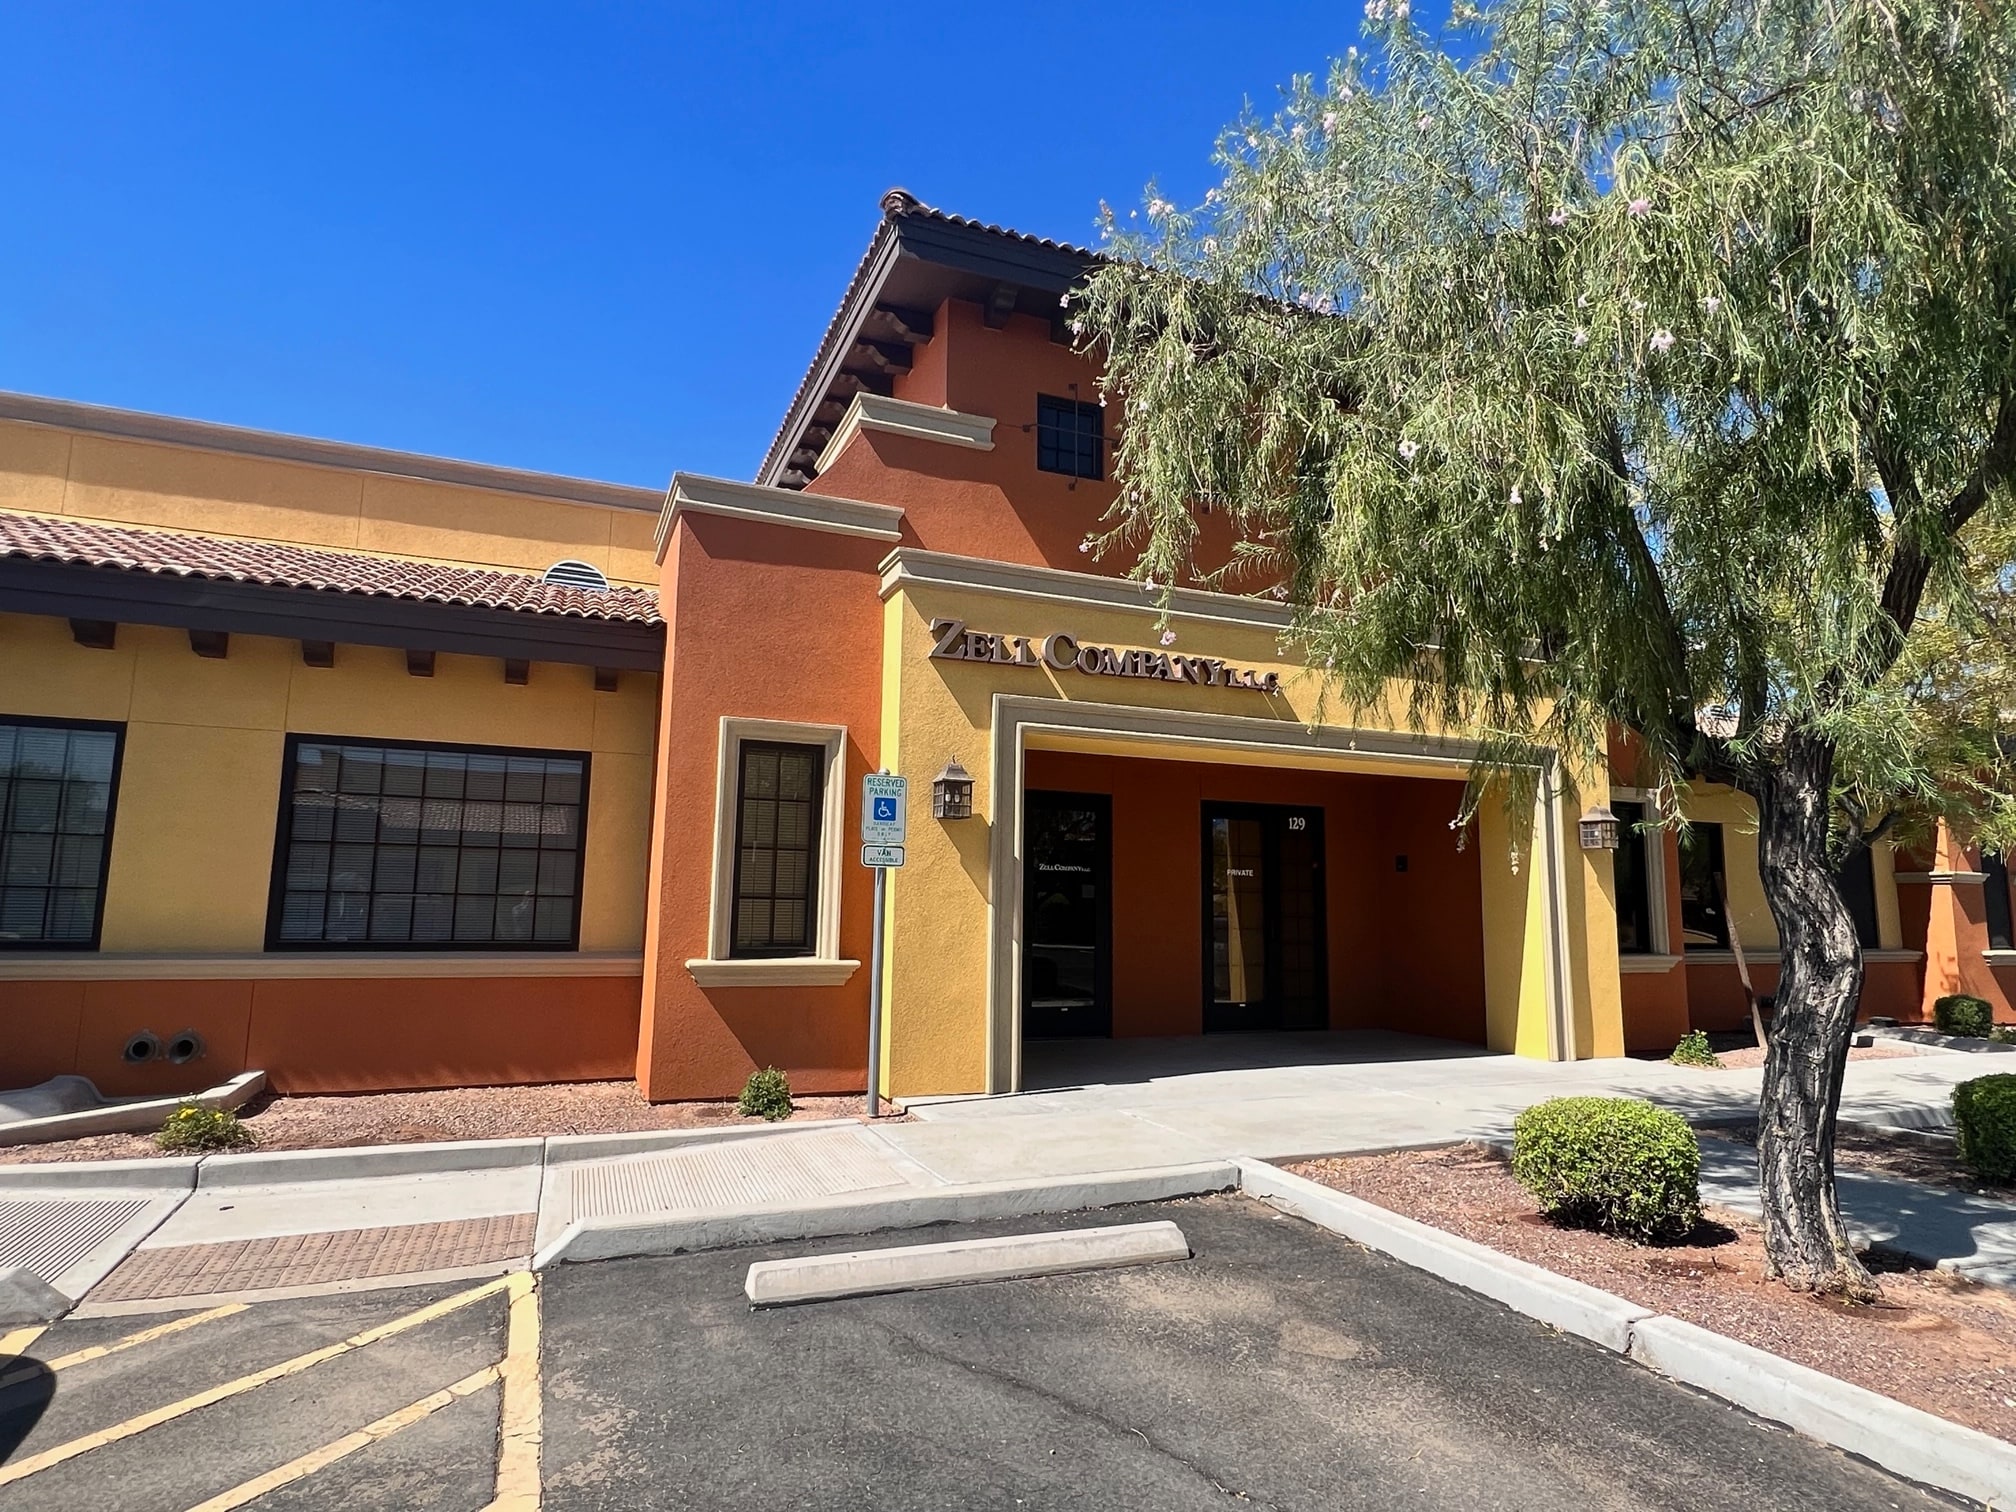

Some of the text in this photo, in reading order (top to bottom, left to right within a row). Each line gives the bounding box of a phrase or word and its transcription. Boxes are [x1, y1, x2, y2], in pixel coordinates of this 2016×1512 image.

[928, 617, 1040, 667] ZELL
[1041, 632, 1226, 687] COMPANY
[867, 778, 905, 788] RESERVED
[869, 788, 902, 797] PARKING
[1288, 817, 1306, 830] 129
[1226, 868, 1254, 877] PRIVATE
